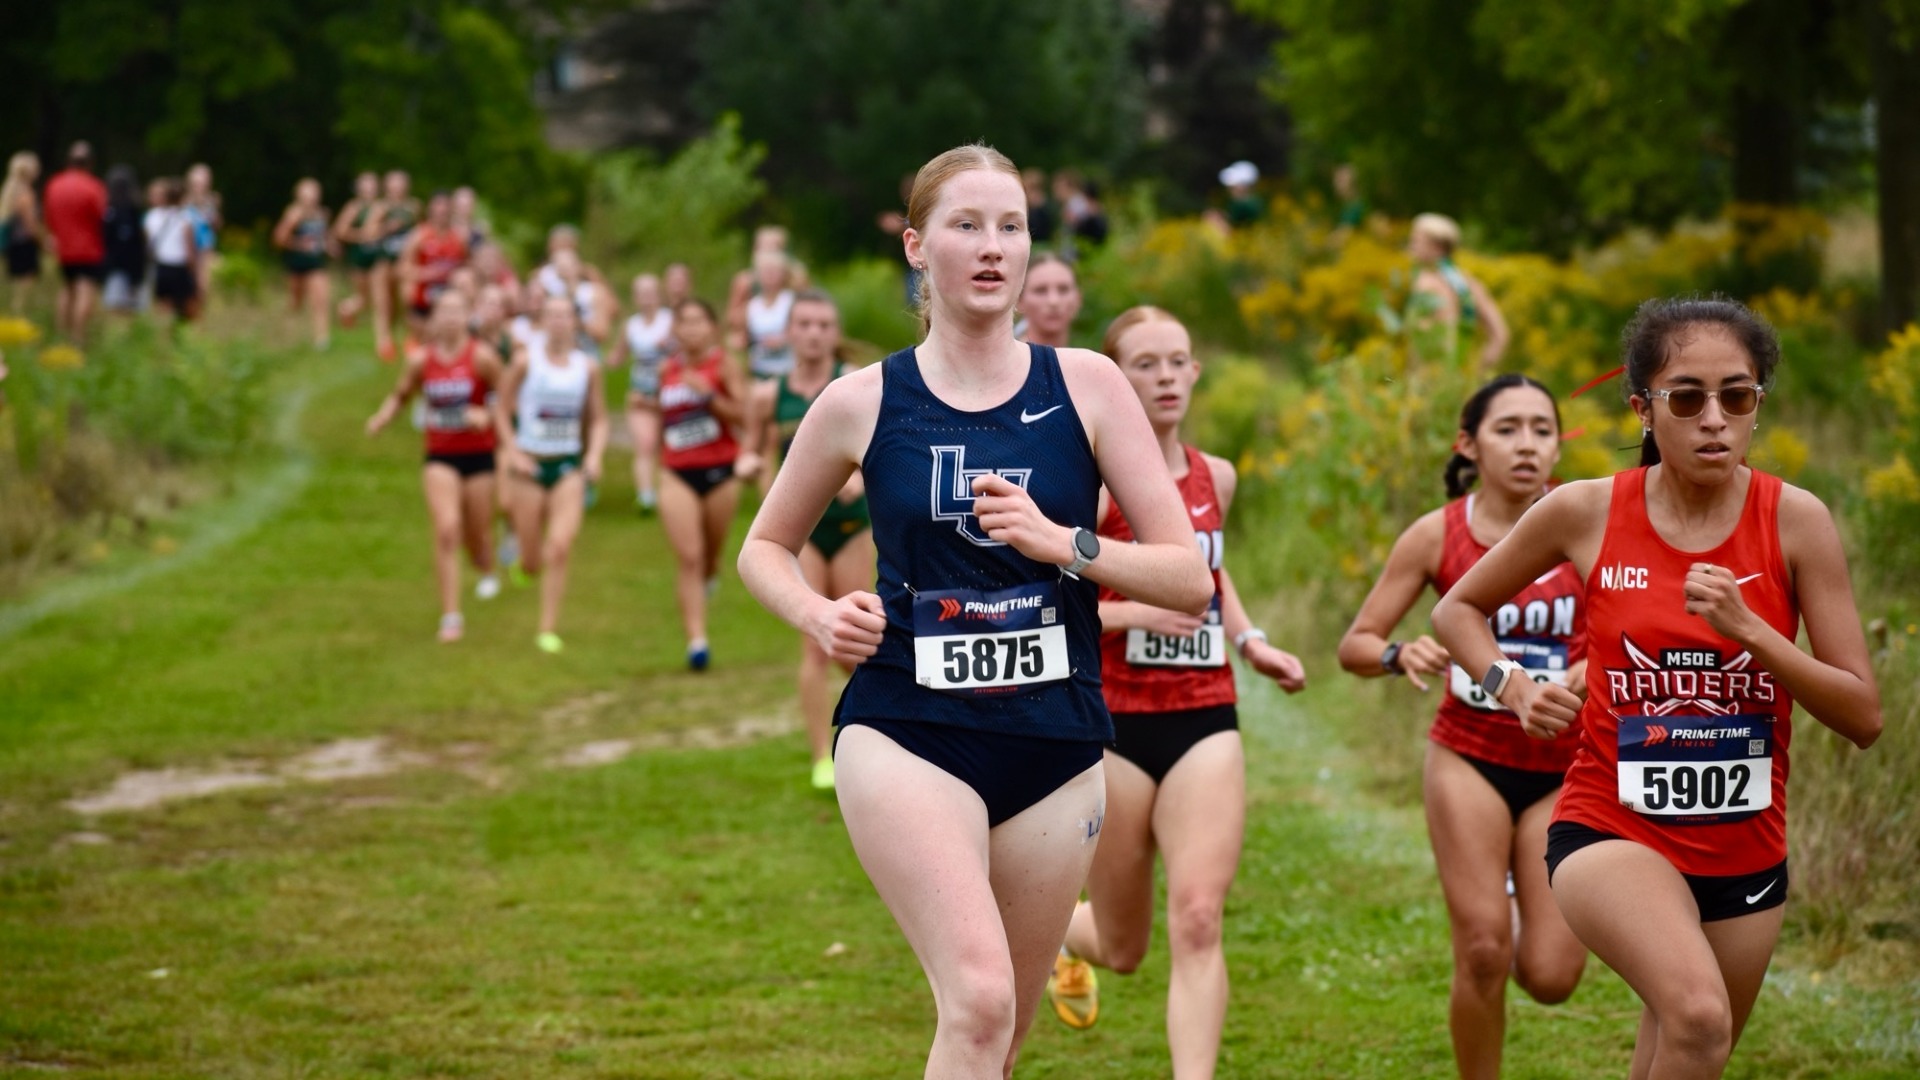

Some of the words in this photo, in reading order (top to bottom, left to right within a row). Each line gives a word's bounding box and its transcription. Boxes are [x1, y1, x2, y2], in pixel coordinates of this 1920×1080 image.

[1600, 561, 1648, 591] NACC
[964, 595, 1043, 613] PRIMETIME
[965, 612, 1006, 620] TIMING
[1487, 595, 1576, 636] PON
[943, 634, 1044, 683] 5875
[1145, 630, 1210, 660] 5940
[1666, 652, 1715, 666] MSOE
[1606, 670, 1774, 703] RAIDERS
[1671, 727, 1751, 740] PRIMETIME
[1643, 764, 1751, 810] 5902
